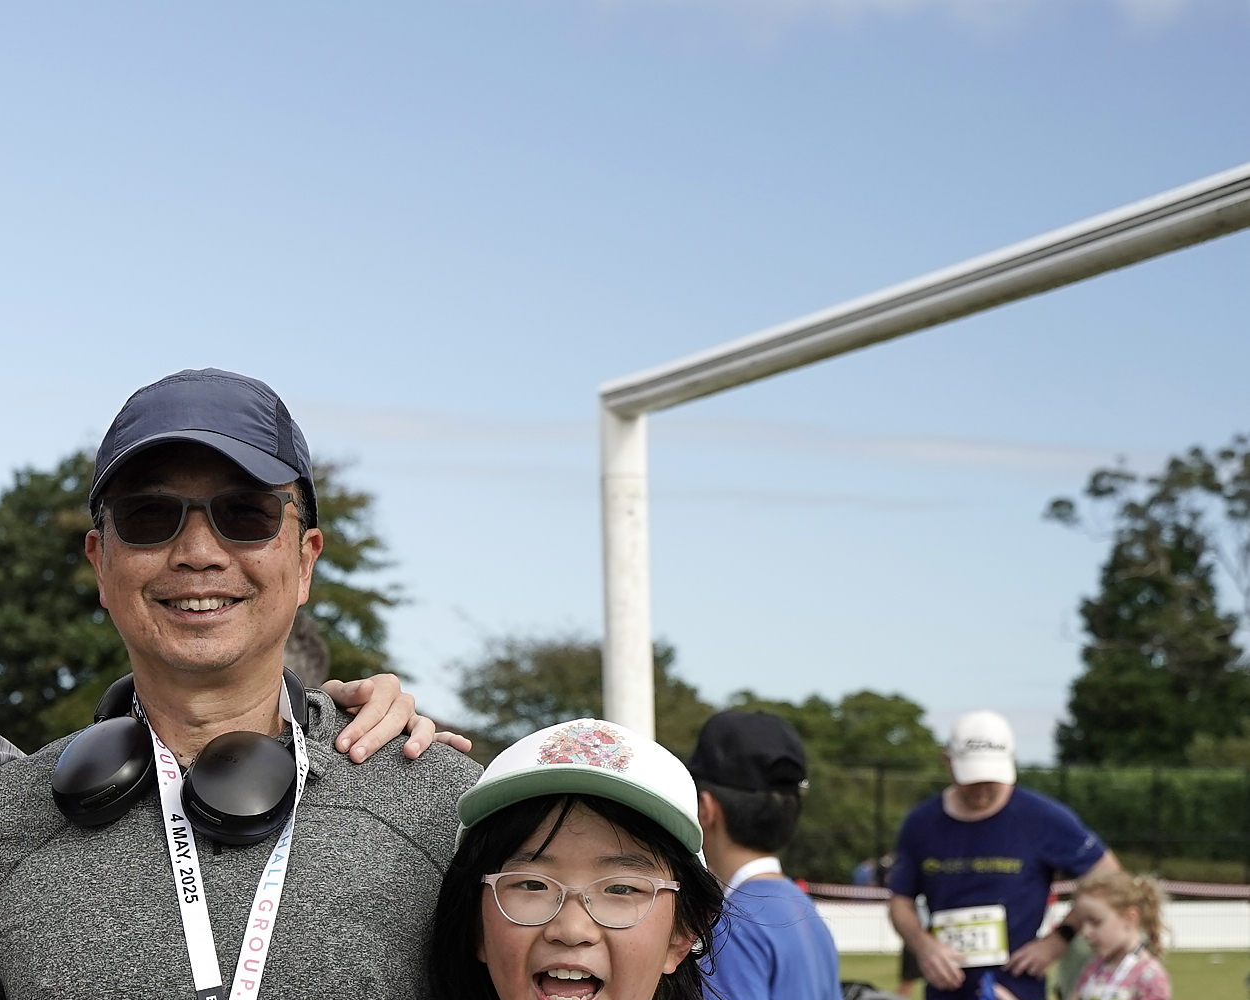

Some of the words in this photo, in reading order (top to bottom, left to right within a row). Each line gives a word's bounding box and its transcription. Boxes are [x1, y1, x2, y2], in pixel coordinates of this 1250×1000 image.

[170, 813, 184, 823] 4
[172, 826, 191, 864] MAY,
[180, 867, 199, 904] 2025
[237, 899, 274, 997] GROUP.
